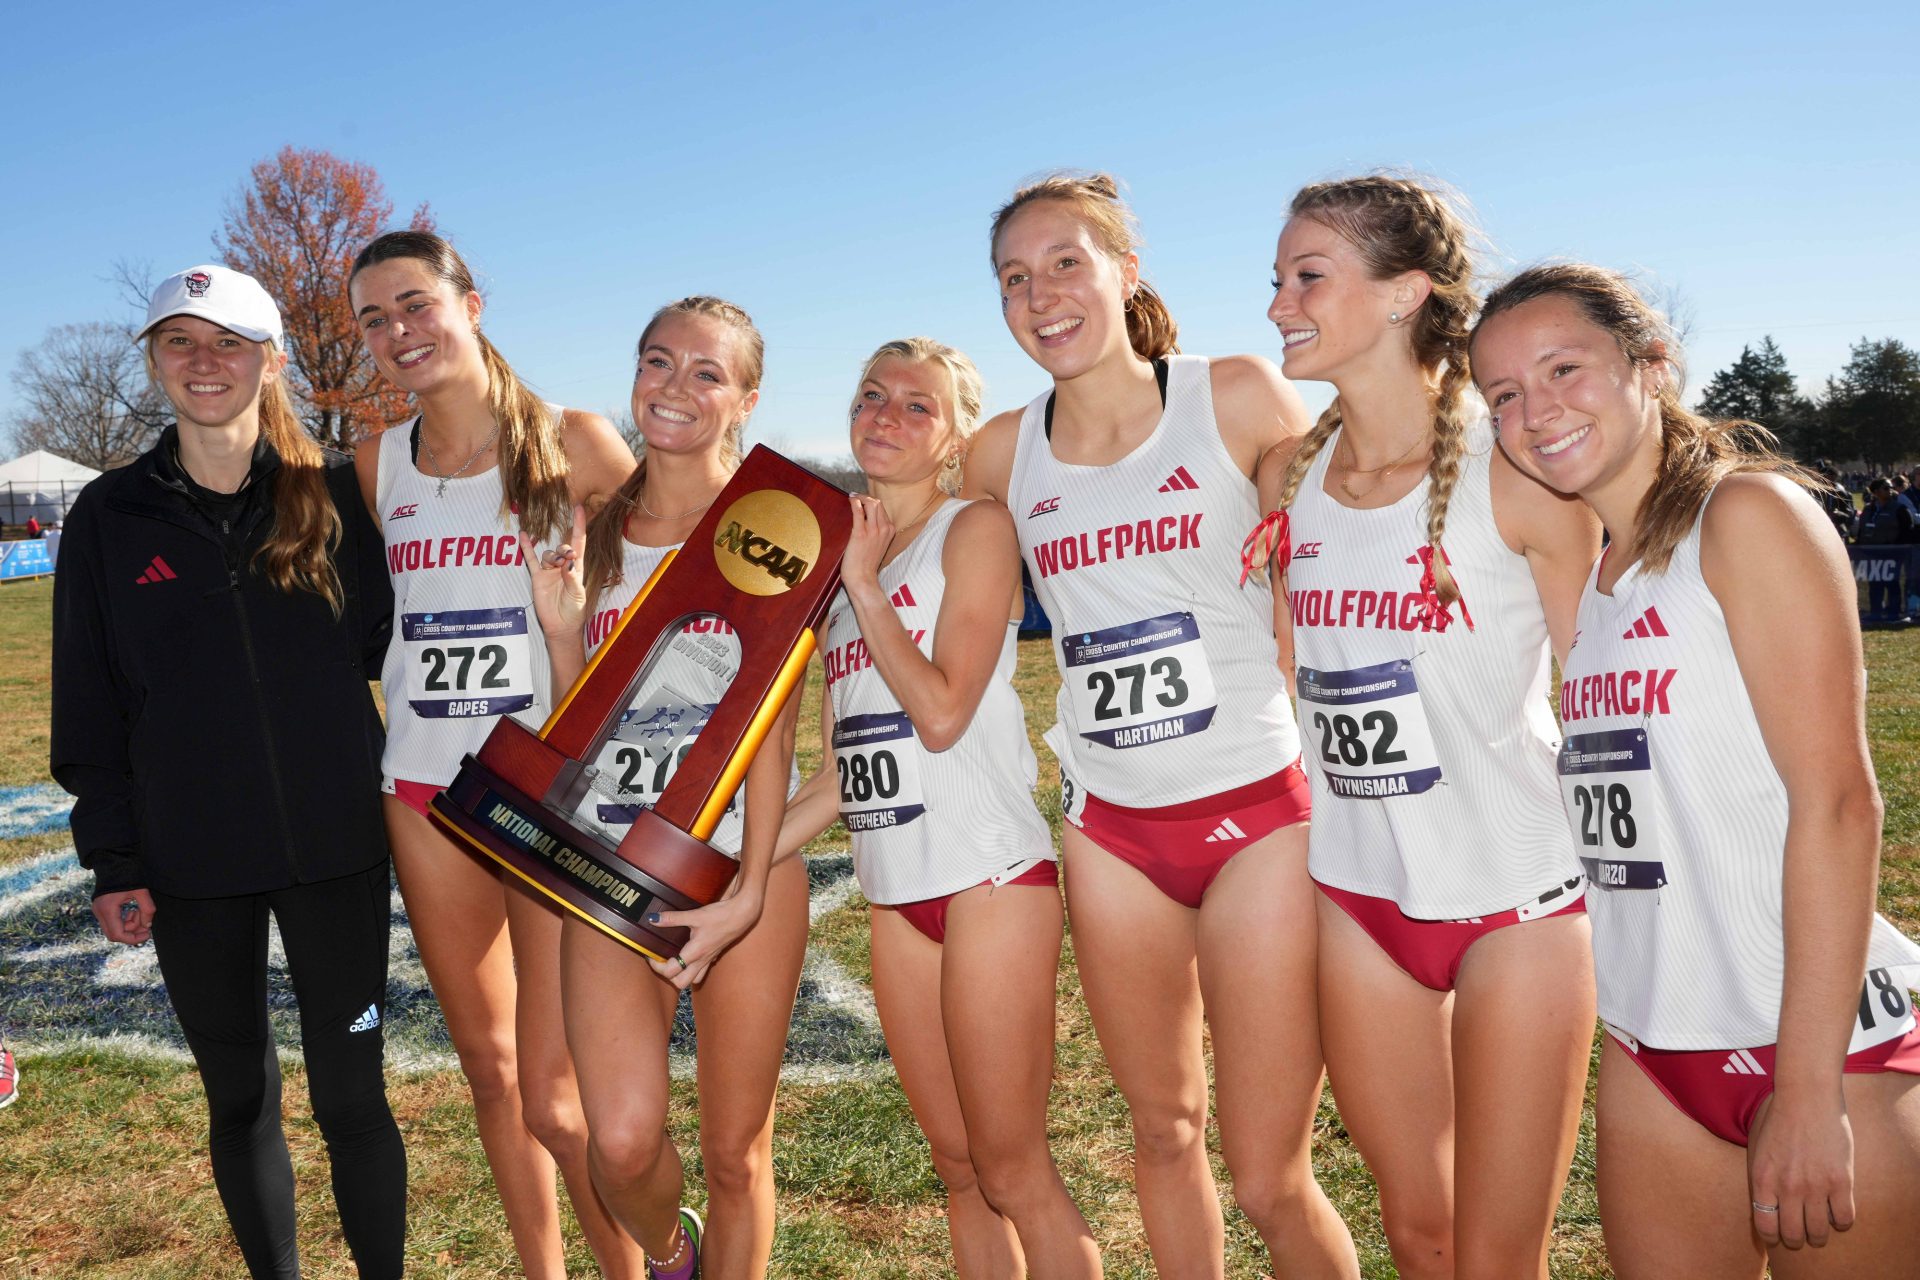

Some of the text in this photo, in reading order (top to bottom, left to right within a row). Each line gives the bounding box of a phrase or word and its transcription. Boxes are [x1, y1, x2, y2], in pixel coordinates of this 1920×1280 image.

[390, 504, 419, 520] ACC
[1028, 497, 1061, 519] ACC
[715, 521, 808, 588] NCAA
[1034, 513, 1203, 578] WOLFPACK
[1292, 542, 1322, 559] ACC
[1850, 559, 1896, 582] AXC
[466, 621, 513, 631] CHAMPIONSHIPS
[697, 634, 729, 657] 2023
[1085, 647, 1102, 656] CROSS
[1103, 641, 1130, 653] COUNTRY
[1131, 627, 1183, 647] CHAMPIONSHIPS
[421, 644, 511, 691] 272
[673, 636, 730, 678] DIVISION
[1087, 656, 1189, 721] 273
[1321, 688, 1340, 696] COUNTRY
[1341, 680, 1397, 696] CHAMPIONSHIPS
[1561, 669, 1678, 722] OLFPACK
[448, 701, 489, 716] GAPES
[858, 724, 899, 736] CHAMPIONSHIPS
[1114, 718, 1184, 747] HARTMAN
[1313, 710, 1408, 767] 282
[837, 750, 900, 803] 280
[1332, 776, 1409, 797] TYYNISMAA
[848, 810, 897, 830] STEPHENS
[1573, 782, 1637, 849] 278
[488, 803, 641, 908] NATIONAL CHAMPION
[350, 1019, 380, 1032] adidas
